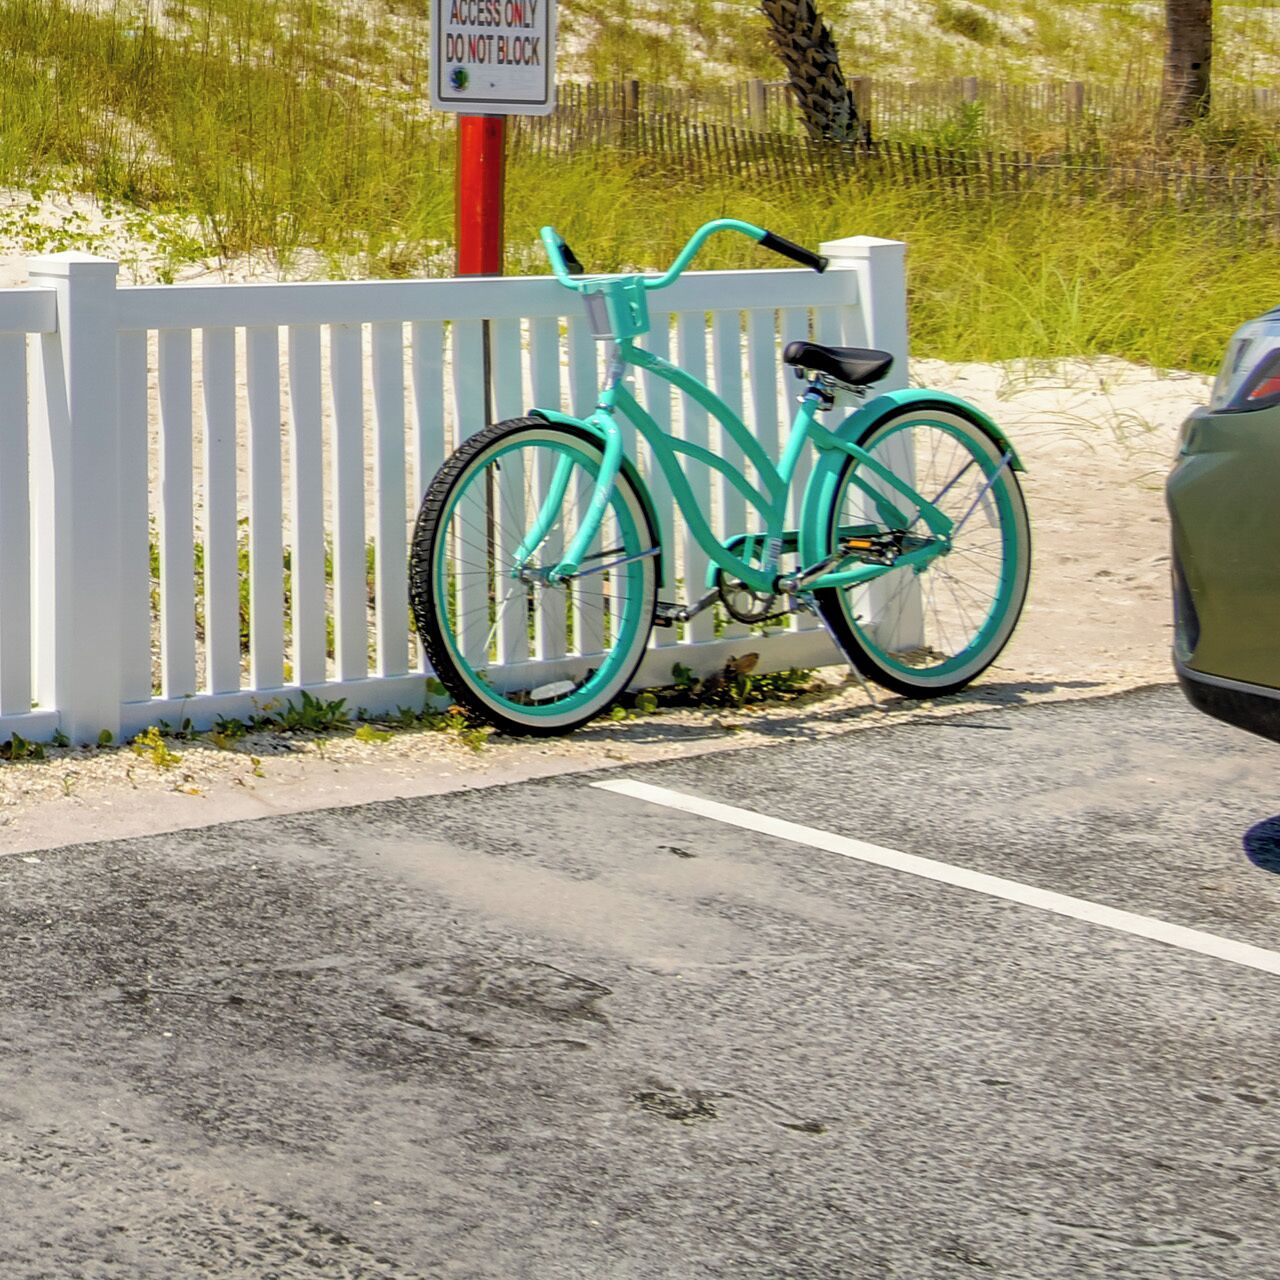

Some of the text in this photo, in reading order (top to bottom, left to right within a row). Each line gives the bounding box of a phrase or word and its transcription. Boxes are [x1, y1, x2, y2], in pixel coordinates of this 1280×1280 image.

[505, 0, 537, 28] ONLY
[446, 33, 540, 66] DO NOT BLOCK
